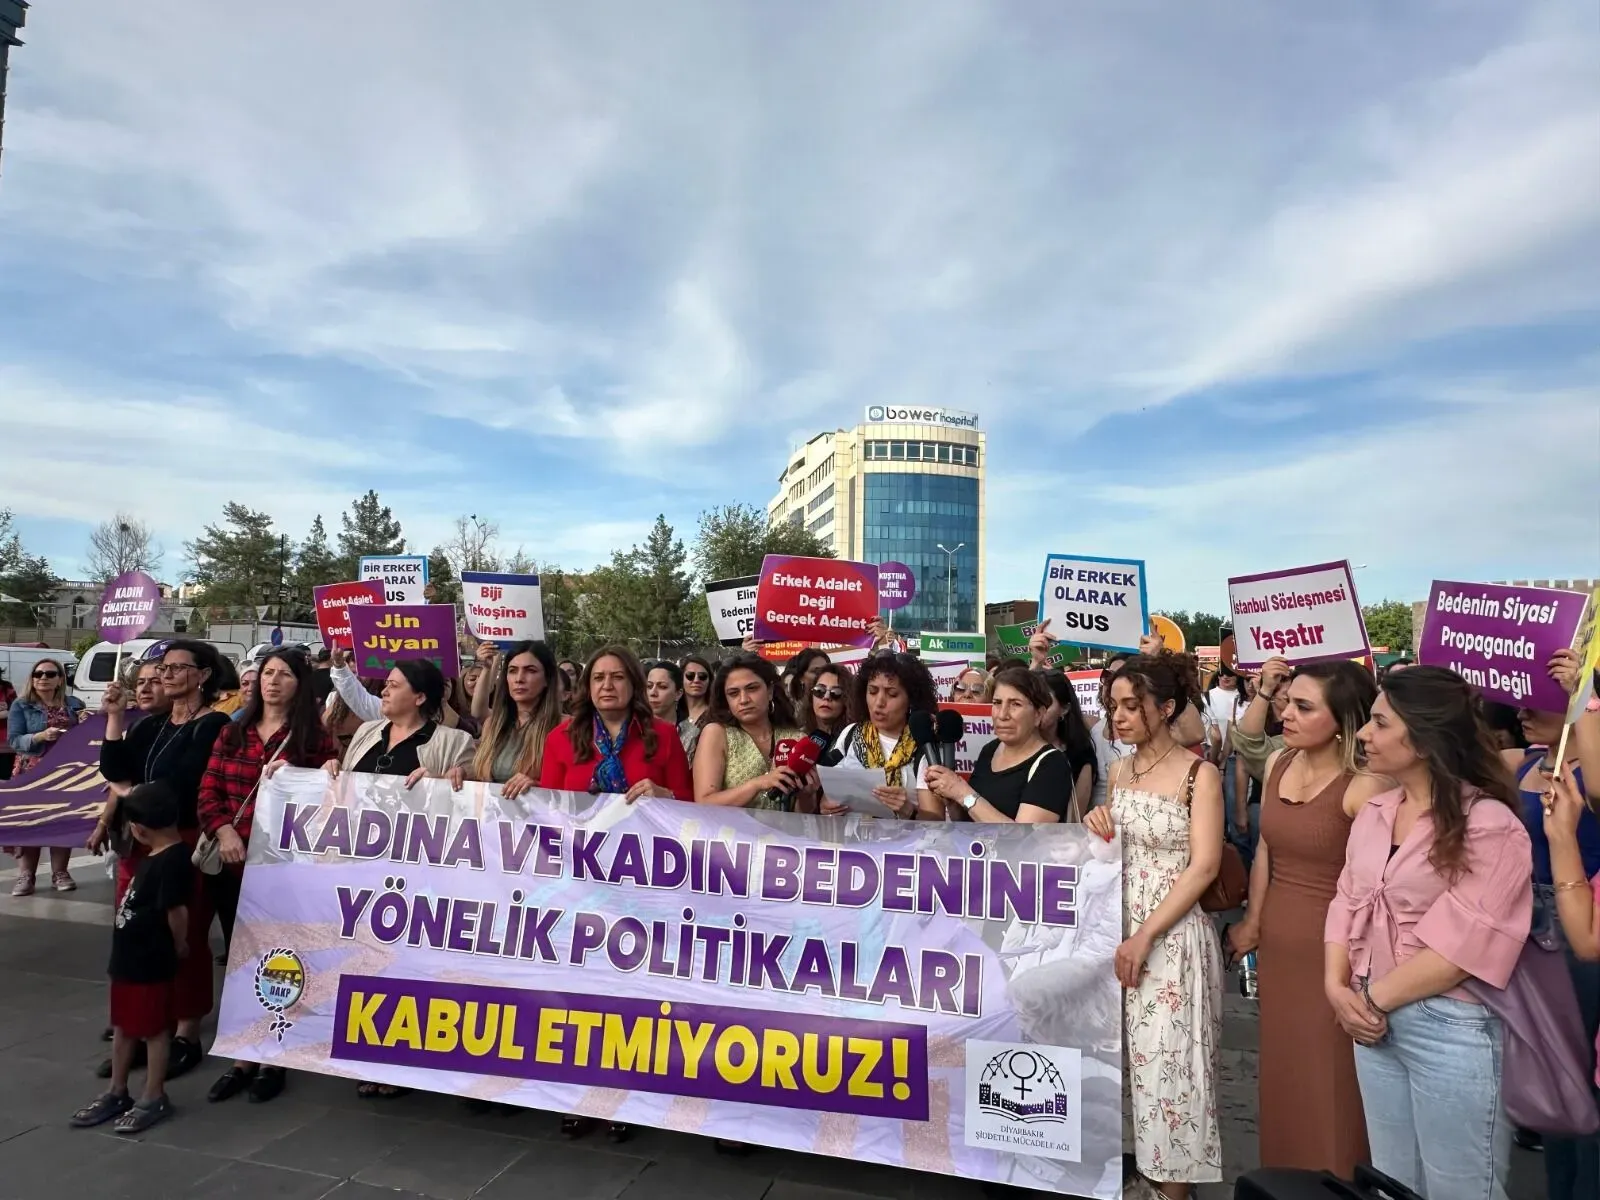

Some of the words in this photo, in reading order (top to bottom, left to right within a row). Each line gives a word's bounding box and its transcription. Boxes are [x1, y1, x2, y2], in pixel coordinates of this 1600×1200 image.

[886, 406, 940, 421] bower
[940, 412, 976, 427] hospital
[363, 563, 381, 573] BİR
[383, 564, 421, 572] ERKEK
[1050, 564, 1074, 581] BİR
[1077, 569, 1136, 587] ERKEK
[368, 576, 416, 585] OARAK
[772, 573, 811, 589] Erkek
[814, 576, 863, 592] Adalet
[115, 587, 144, 599] KADIN
[322, 597, 347, 608] Erkek
[347, 594, 374, 605] Adalet
[386, 591, 405, 602] US
[1055, 586, 1127, 607] OLARAK
[1271, 583, 1346, 610] Sözleşmesi
[102, 599, 154, 613] CİNAYETLERİ
[468, 603, 527, 620] Tekoşîna
[799, 595, 835, 611] Değil
[1436, 591, 1500, 618] Bedenim
[1502, 597, 1559, 626] Siyasi
[101, 613, 146, 627] POLİTİKTİR
[375, 613, 420, 628] Jin
[476, 622, 513, 636] Jinan
[737, 618, 754, 636] ÇE
[766, 611, 816, 629] Gerçek
[819, 613, 867, 630] Adalet
[1066, 611, 1110, 632] SUS
[327, 626, 352, 636] Gerçe
[1250, 623, 1324, 655] Yaşatır
[363, 635, 439, 653] Jiyan
[1440, 625, 1535, 660] Propaganda
[1489, 668, 1533, 700] Değil
[279, 802, 485, 871] KADINA
[498, 820, 563, 878] VE
[571, 829, 752, 899] KADIN
[760, 840, 1078, 929] BEDENİNE
[335, 876, 566, 964] YÖNELİK
[568, 907, 985, 1018] POLİTİKALARI
[345, 991, 525, 1061] KABUL
[534, 1001, 911, 1101] ETMİYORUZ!
[1000, 1124, 1044, 1138] DİYARBAKIR
[975, 1130, 1011, 1143] ŞİDDETLE
[1012, 1135, 1055, 1149] MÜCADELE
[1055, 1142, 1070, 1152] AĞI
